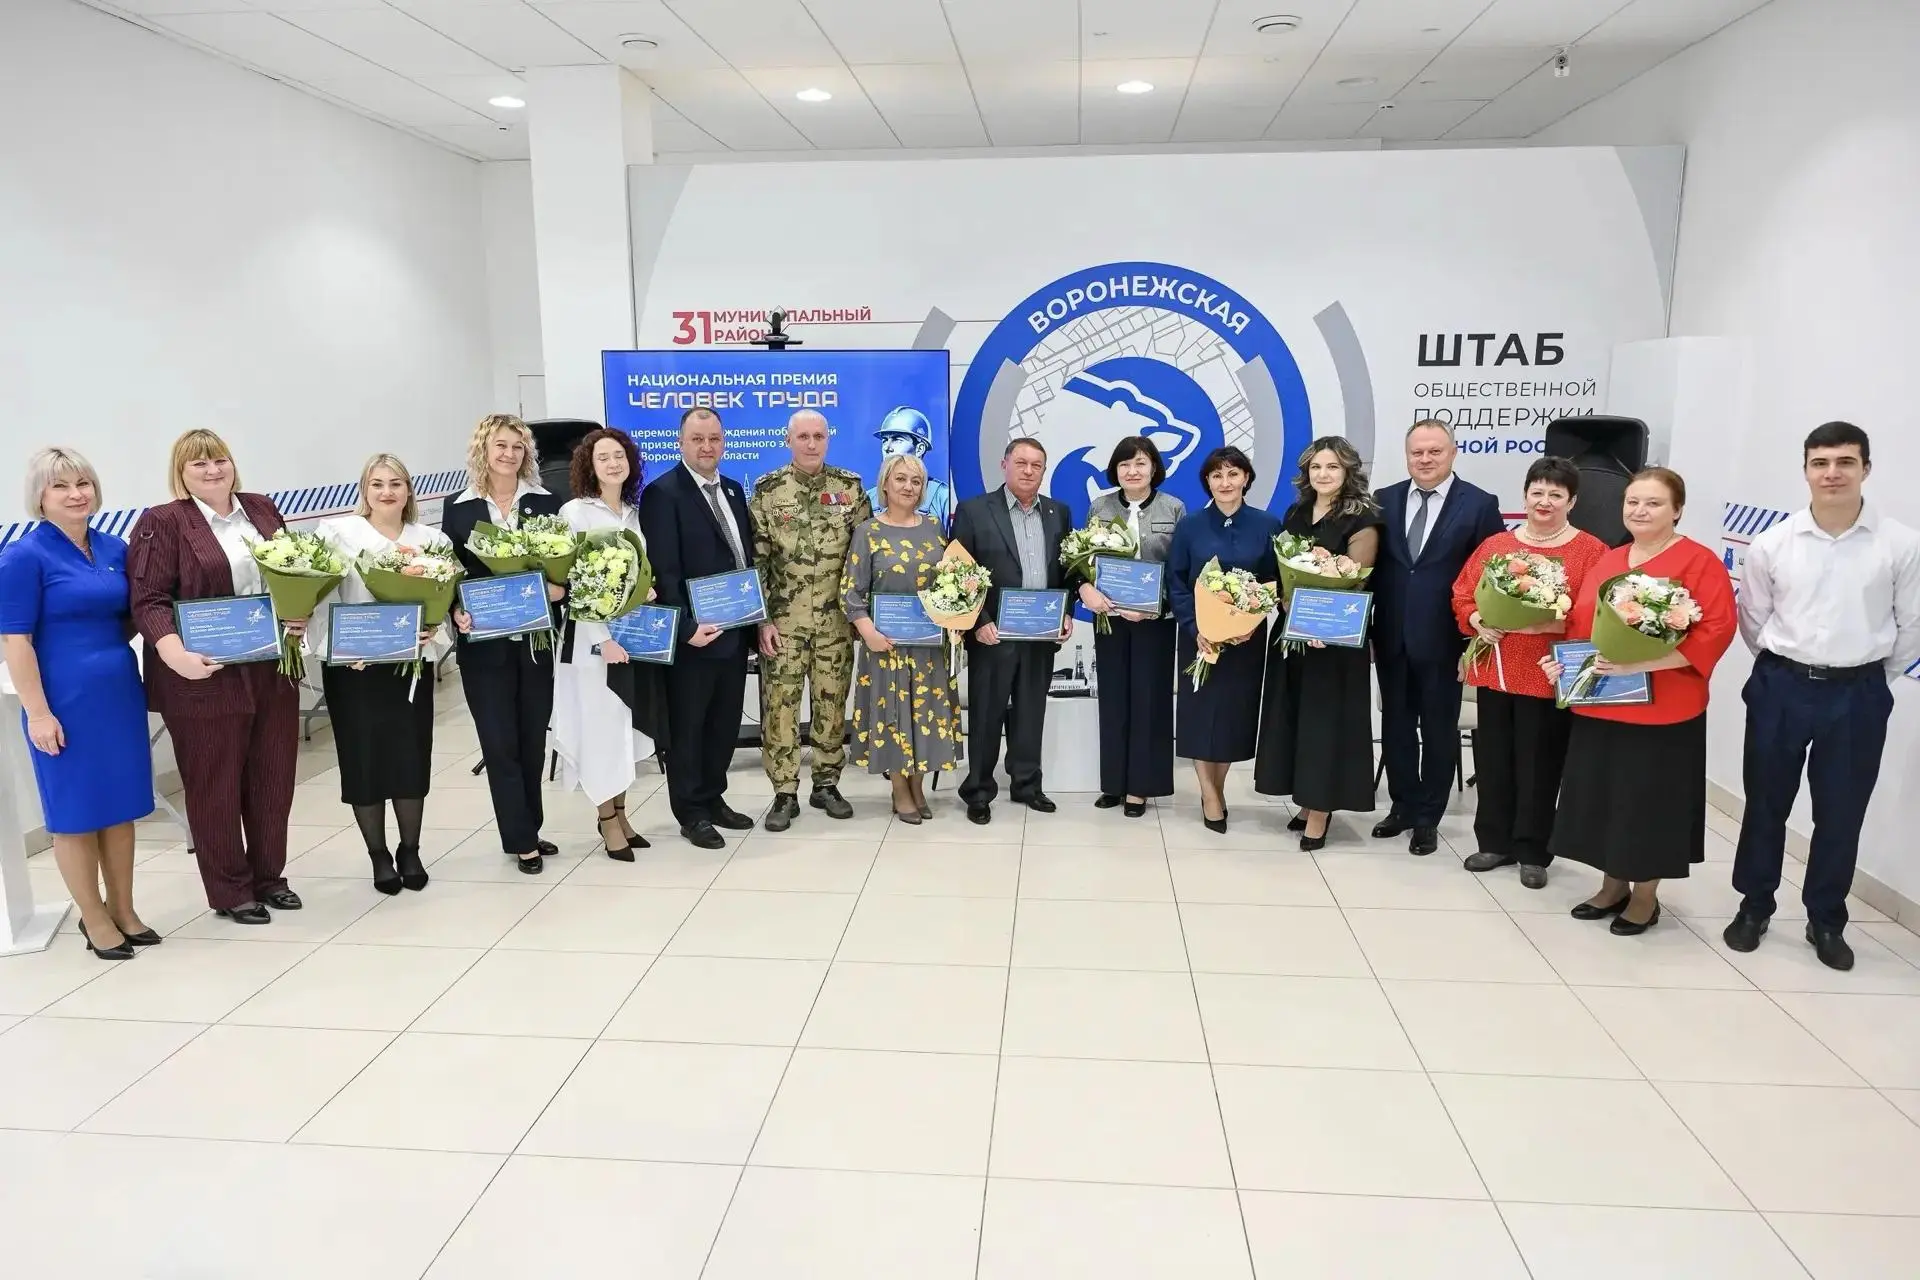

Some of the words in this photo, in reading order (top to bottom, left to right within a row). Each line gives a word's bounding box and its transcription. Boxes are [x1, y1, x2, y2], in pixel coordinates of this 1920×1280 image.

[1027, 275, 1251, 335] ВОРОНЕЖСКАЯ
[714, 306, 871, 323] МУНИЦПАЛЬНЫЙ
[672, 311, 712, 345] 31
[1418, 333, 1565, 366] ШТАБ
[627, 374, 766, 388] НАЦИОНАЛЬНАЯ
[771, 373, 838, 386] ПРЕМИЯ
[1414, 378, 1596, 399] ОБЩЕСТВЕННОЙ
[629, 391, 744, 408] ЧЕЛОВЕК
[752, 391, 838, 407] ТРУДА
[631, 429, 679, 439] церемон
[724, 428, 765, 437] ждения
[641, 441, 680, 450] призер
[725, 440, 776, 448] нального
[1456, 437, 1498, 453] НОЙ
[1505, 440, 1546, 453] РОС
[641, 451, 681, 462] Вороне
[721, 450, 759, 460] бласти
